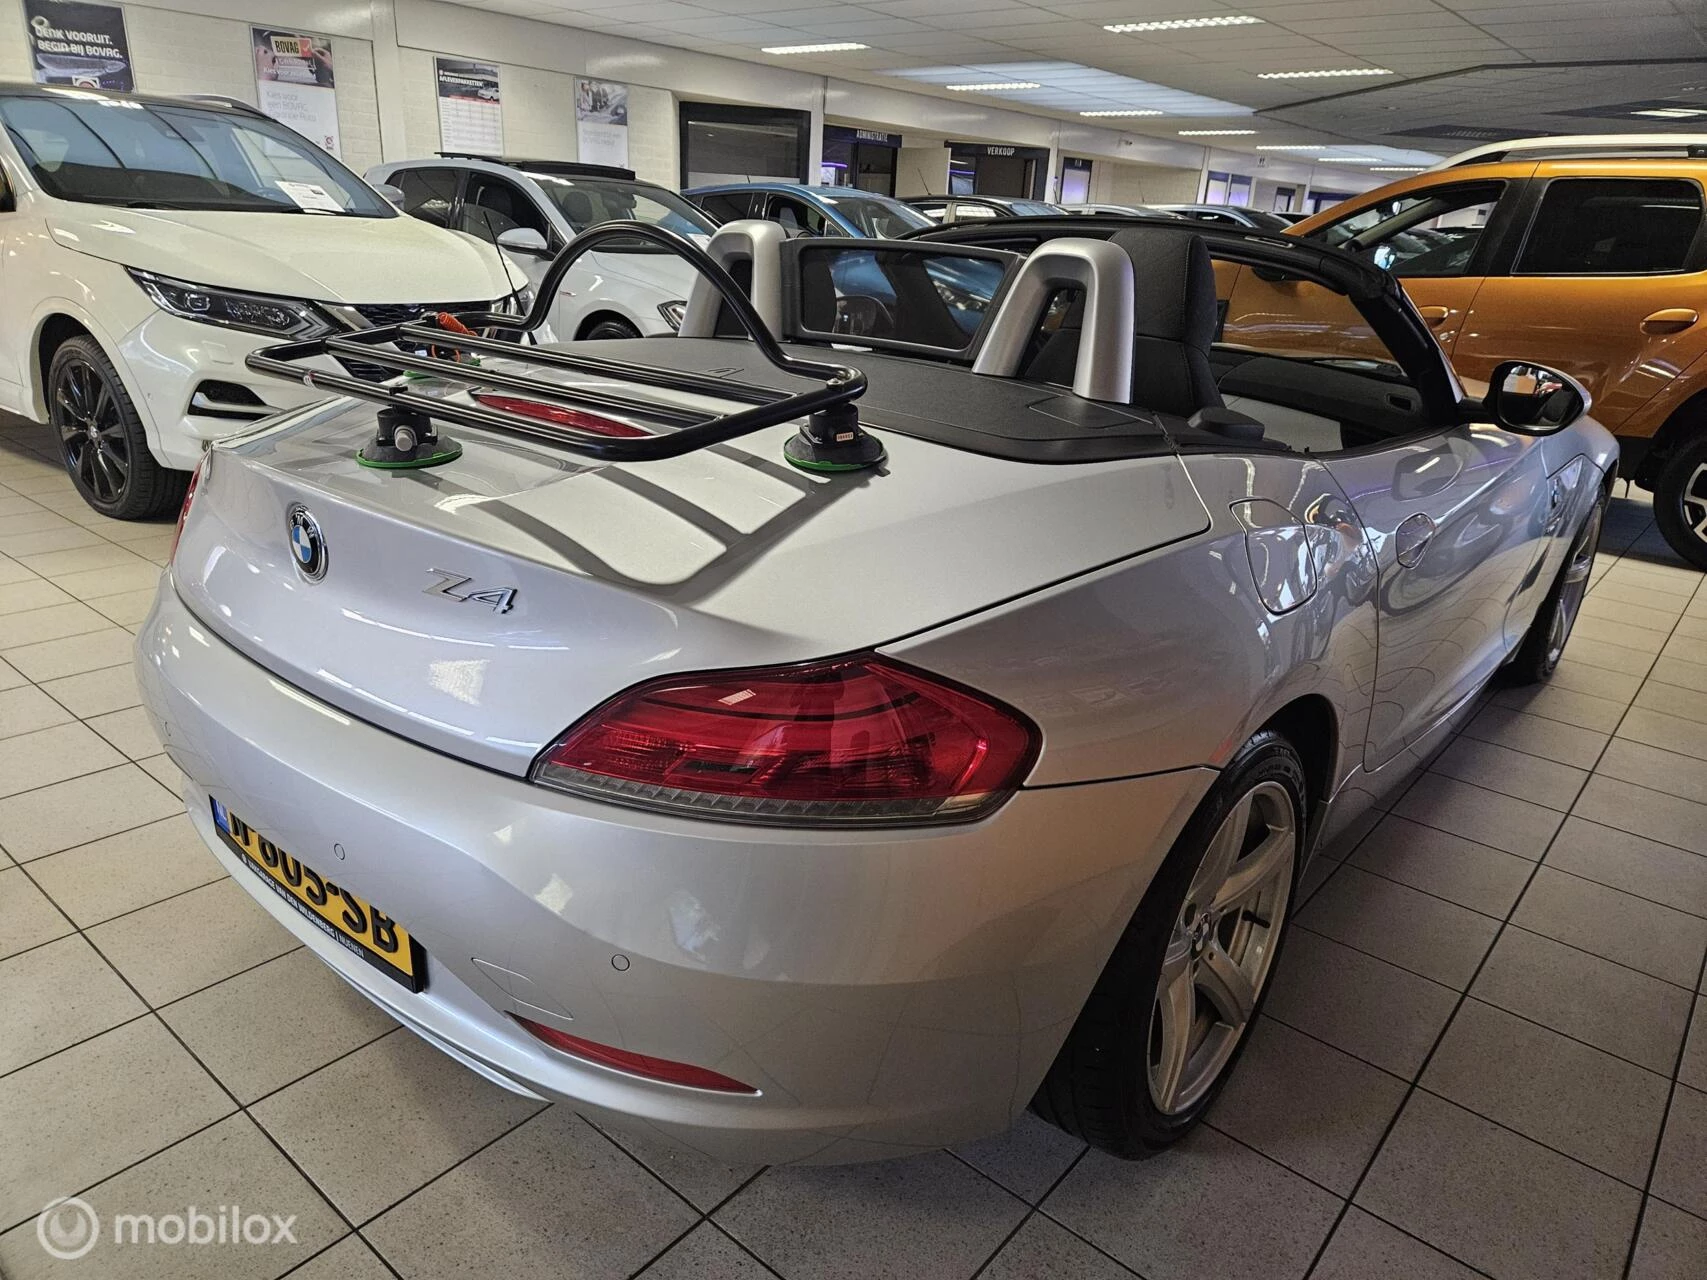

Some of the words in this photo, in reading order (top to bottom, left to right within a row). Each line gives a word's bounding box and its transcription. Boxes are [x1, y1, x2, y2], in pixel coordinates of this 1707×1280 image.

[34, 27, 65, 39] DENK
[66, 30, 113, 45] VOORUIT.
[70, 43, 85, 56] BIJ
[86, 46, 123, 58] BOVAG.
[274, 41, 299, 54] BOVAG
[986, 146, 1015, 157] VERKOOP
[421, 567, 518, 615] Z4
[276, 883, 287, 899] VAN
[287, 892, 298, 909] DEN
[298, 902, 335, 938] WILDENBERG
